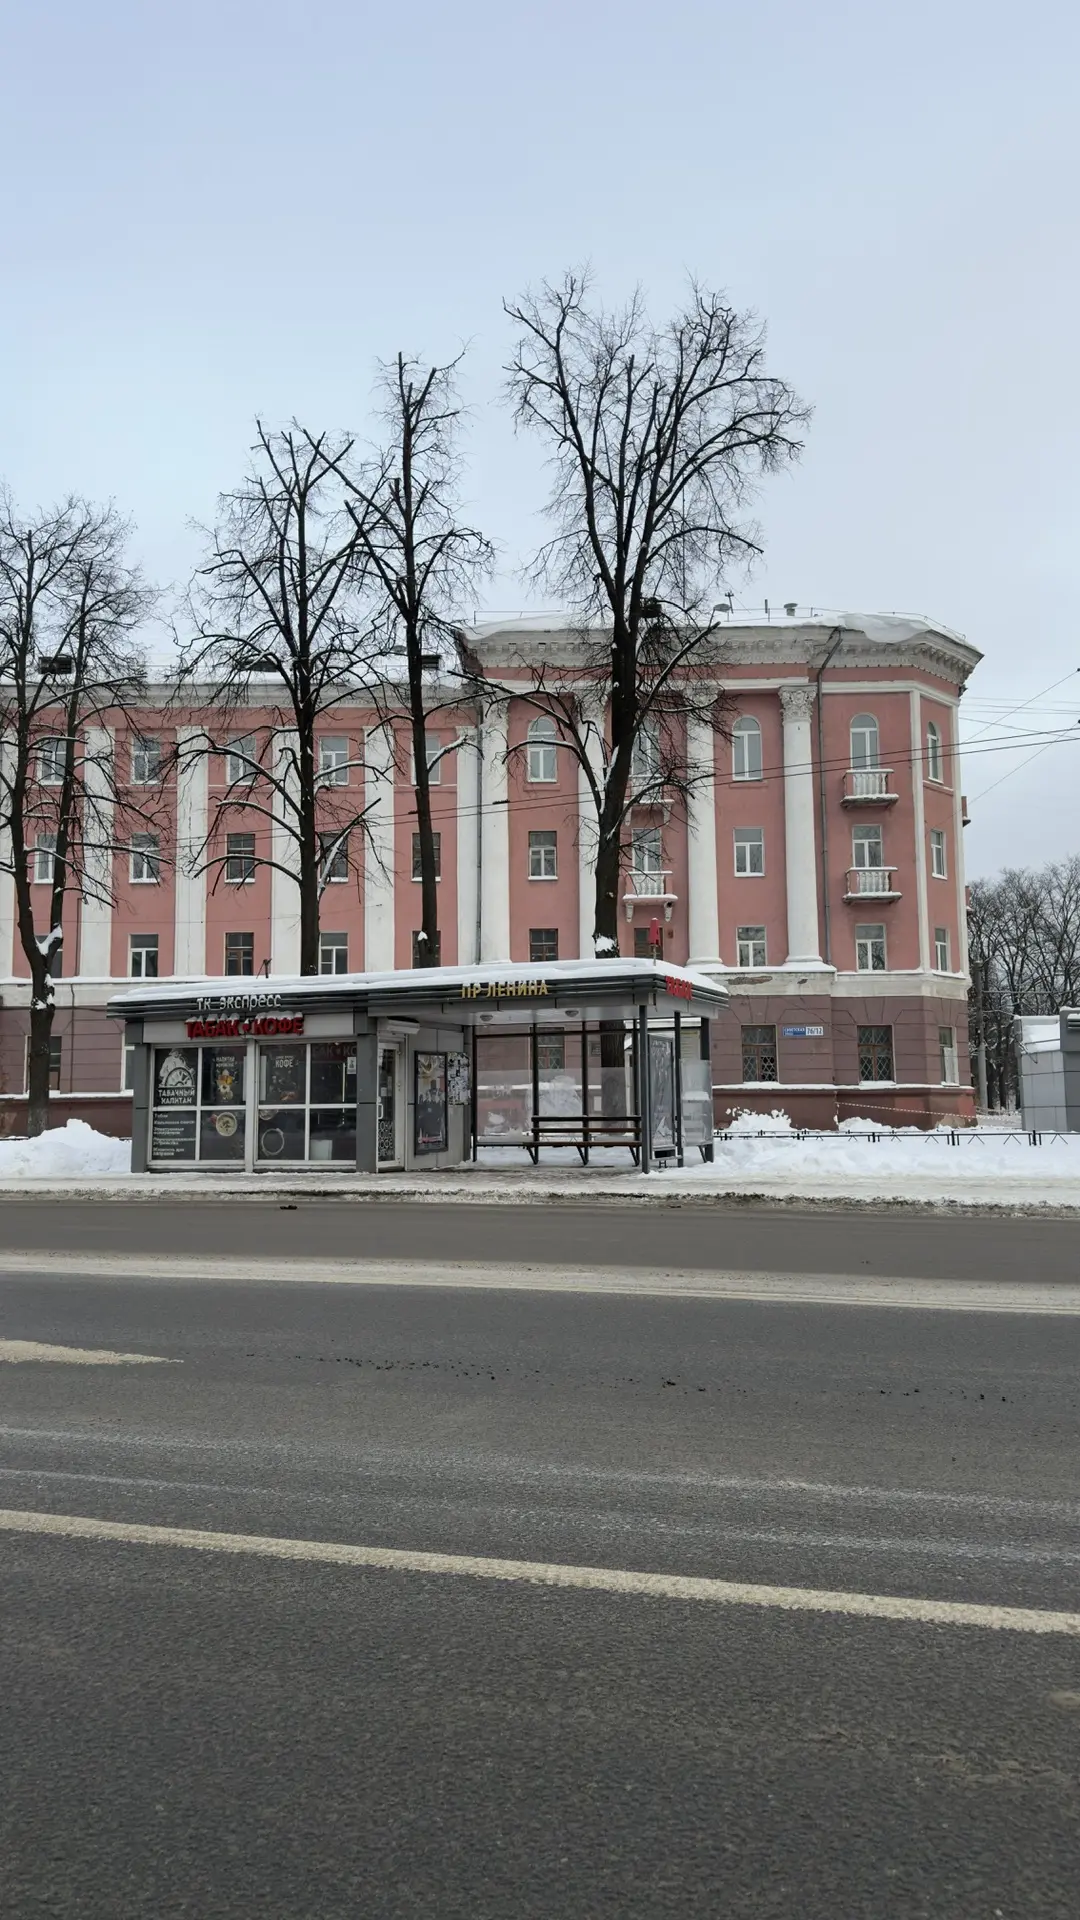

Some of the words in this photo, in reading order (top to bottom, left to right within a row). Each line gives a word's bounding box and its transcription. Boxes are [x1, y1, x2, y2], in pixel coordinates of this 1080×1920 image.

[461, 983, 481, 999] ПР
[486, 979, 549, 997] ЛЕНИНА
[665, 975, 693, 1001] ТАБАК
[185, 1017, 240, 1039] ТАБАК
[252, 1014, 304, 1036] КОФЕ
[275, 1059, 294, 1068] КОФЕ
[158, 1088, 196, 1096] ТАБАЧНЫЙ
